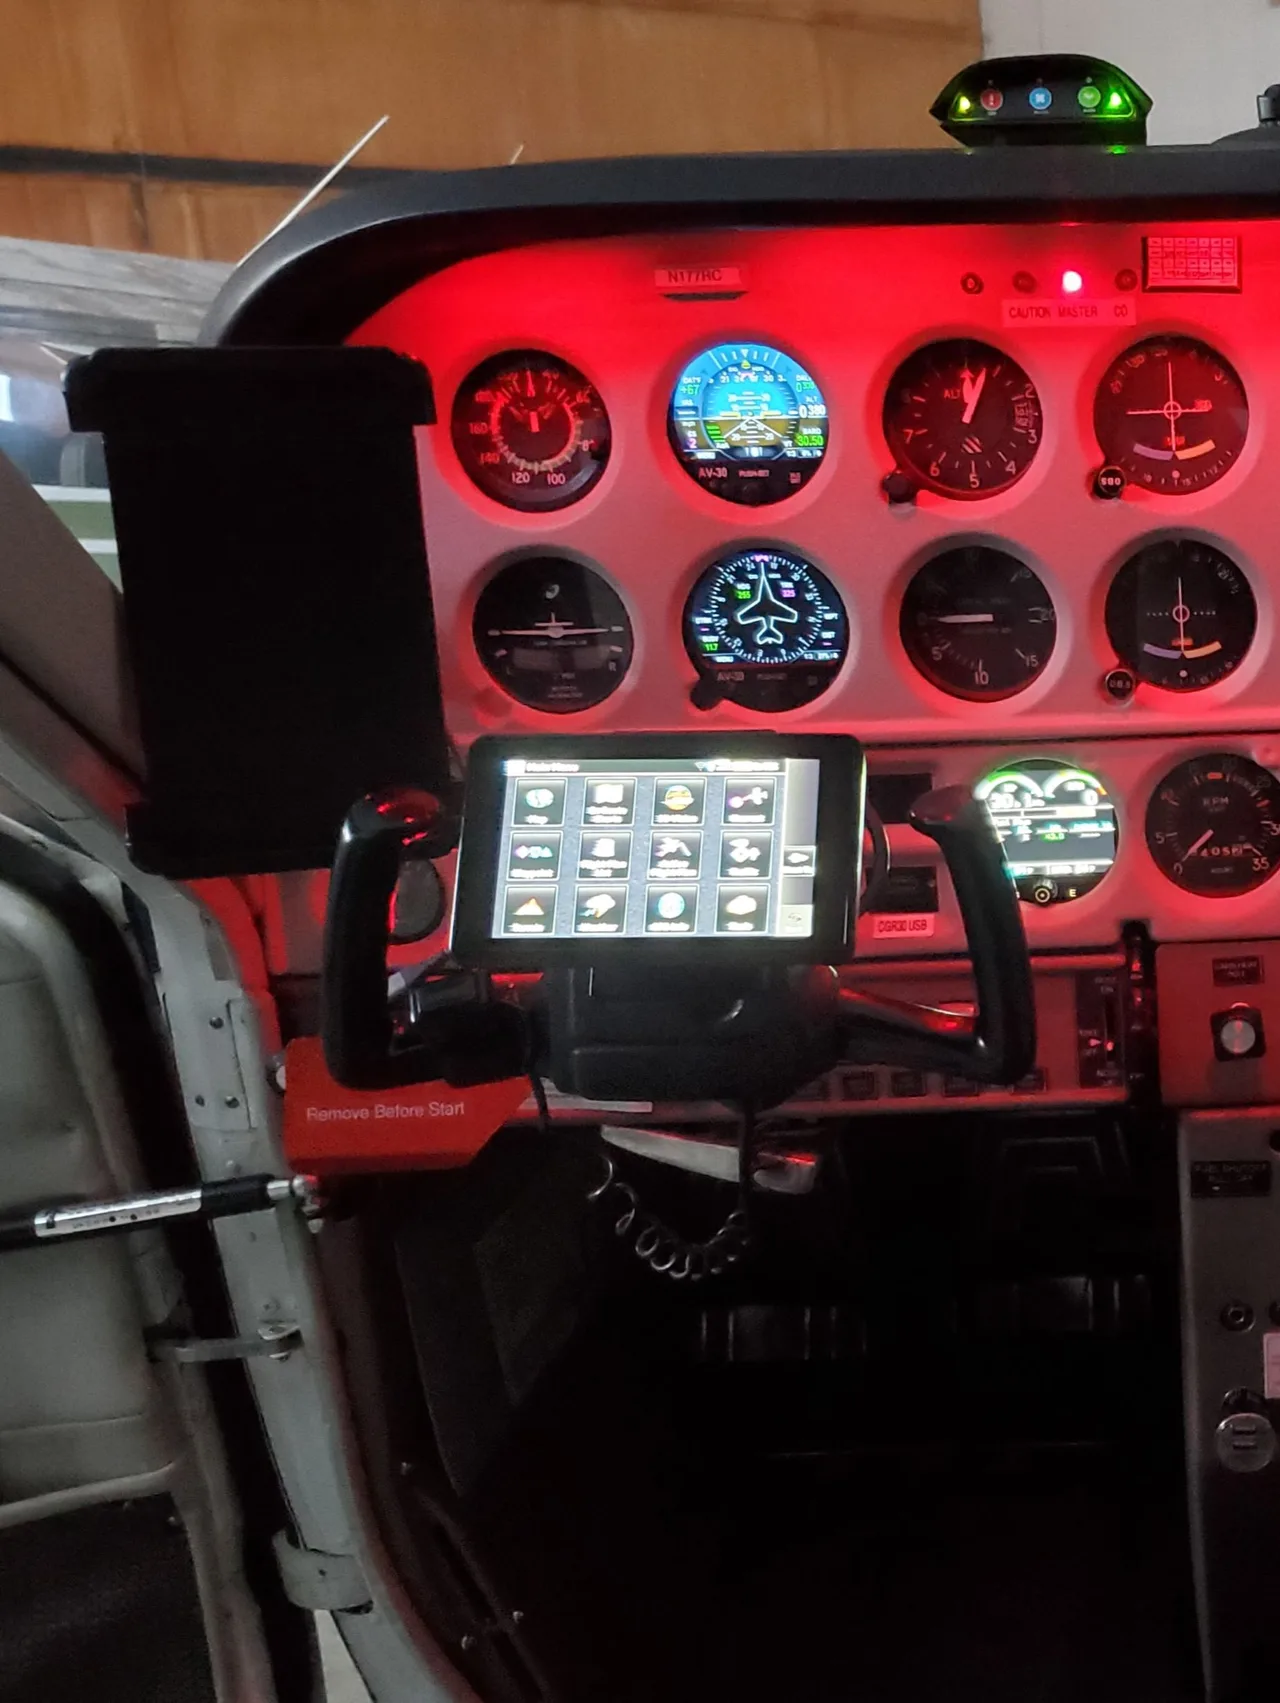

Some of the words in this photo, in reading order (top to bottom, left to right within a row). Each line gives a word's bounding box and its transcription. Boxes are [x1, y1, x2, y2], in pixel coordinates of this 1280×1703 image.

[903, 429, 913, 444] 7
[1028, 430, 1037, 444] 3
[699, 467, 727, 478] AV-30
[930, 462, 940, 476] 6
[1005, 461, 1016, 475] 4
[512, 473, 530, 483] 120
[547, 474, 565, 485] 100
[969, 474, 980, 488] 5
[931, 647, 942, 661] 5
[974, 671, 989, 685] 10
[1156, 831, 1166, 844] 5
[1252, 857, 1270, 872] 35
[908, 919, 928, 931] USB
[306, 1107, 370, 1122] Remove
[374, 1103, 424, 1119] Before
[428, 1101, 465, 1117] Start
